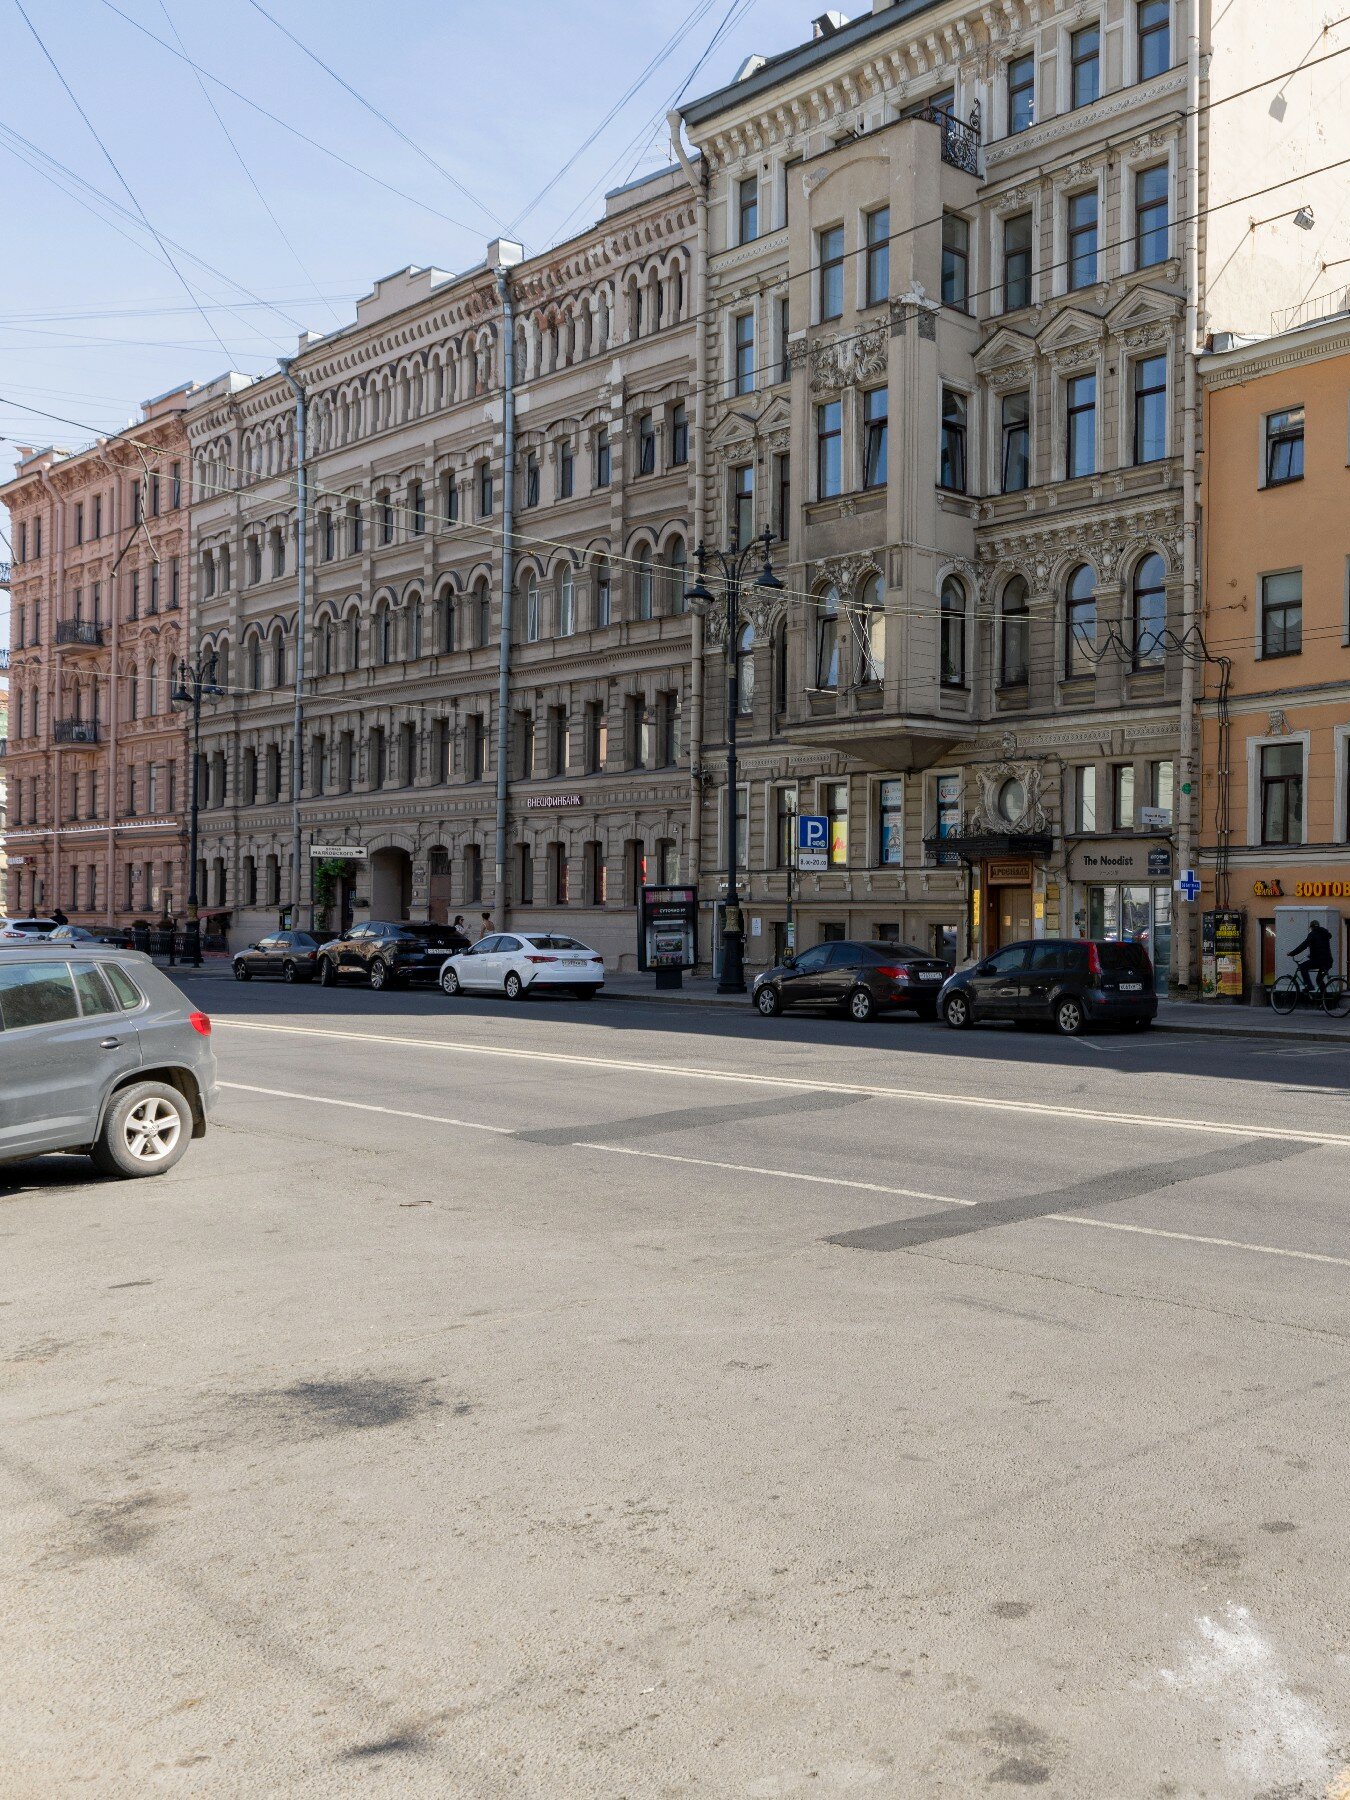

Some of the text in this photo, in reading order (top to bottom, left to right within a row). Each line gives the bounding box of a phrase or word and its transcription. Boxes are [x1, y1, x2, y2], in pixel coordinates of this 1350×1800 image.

[527, 796, 581, 808] ВНЕШФИНБАНК
[1083, 855, 1134, 866] The Noodist
